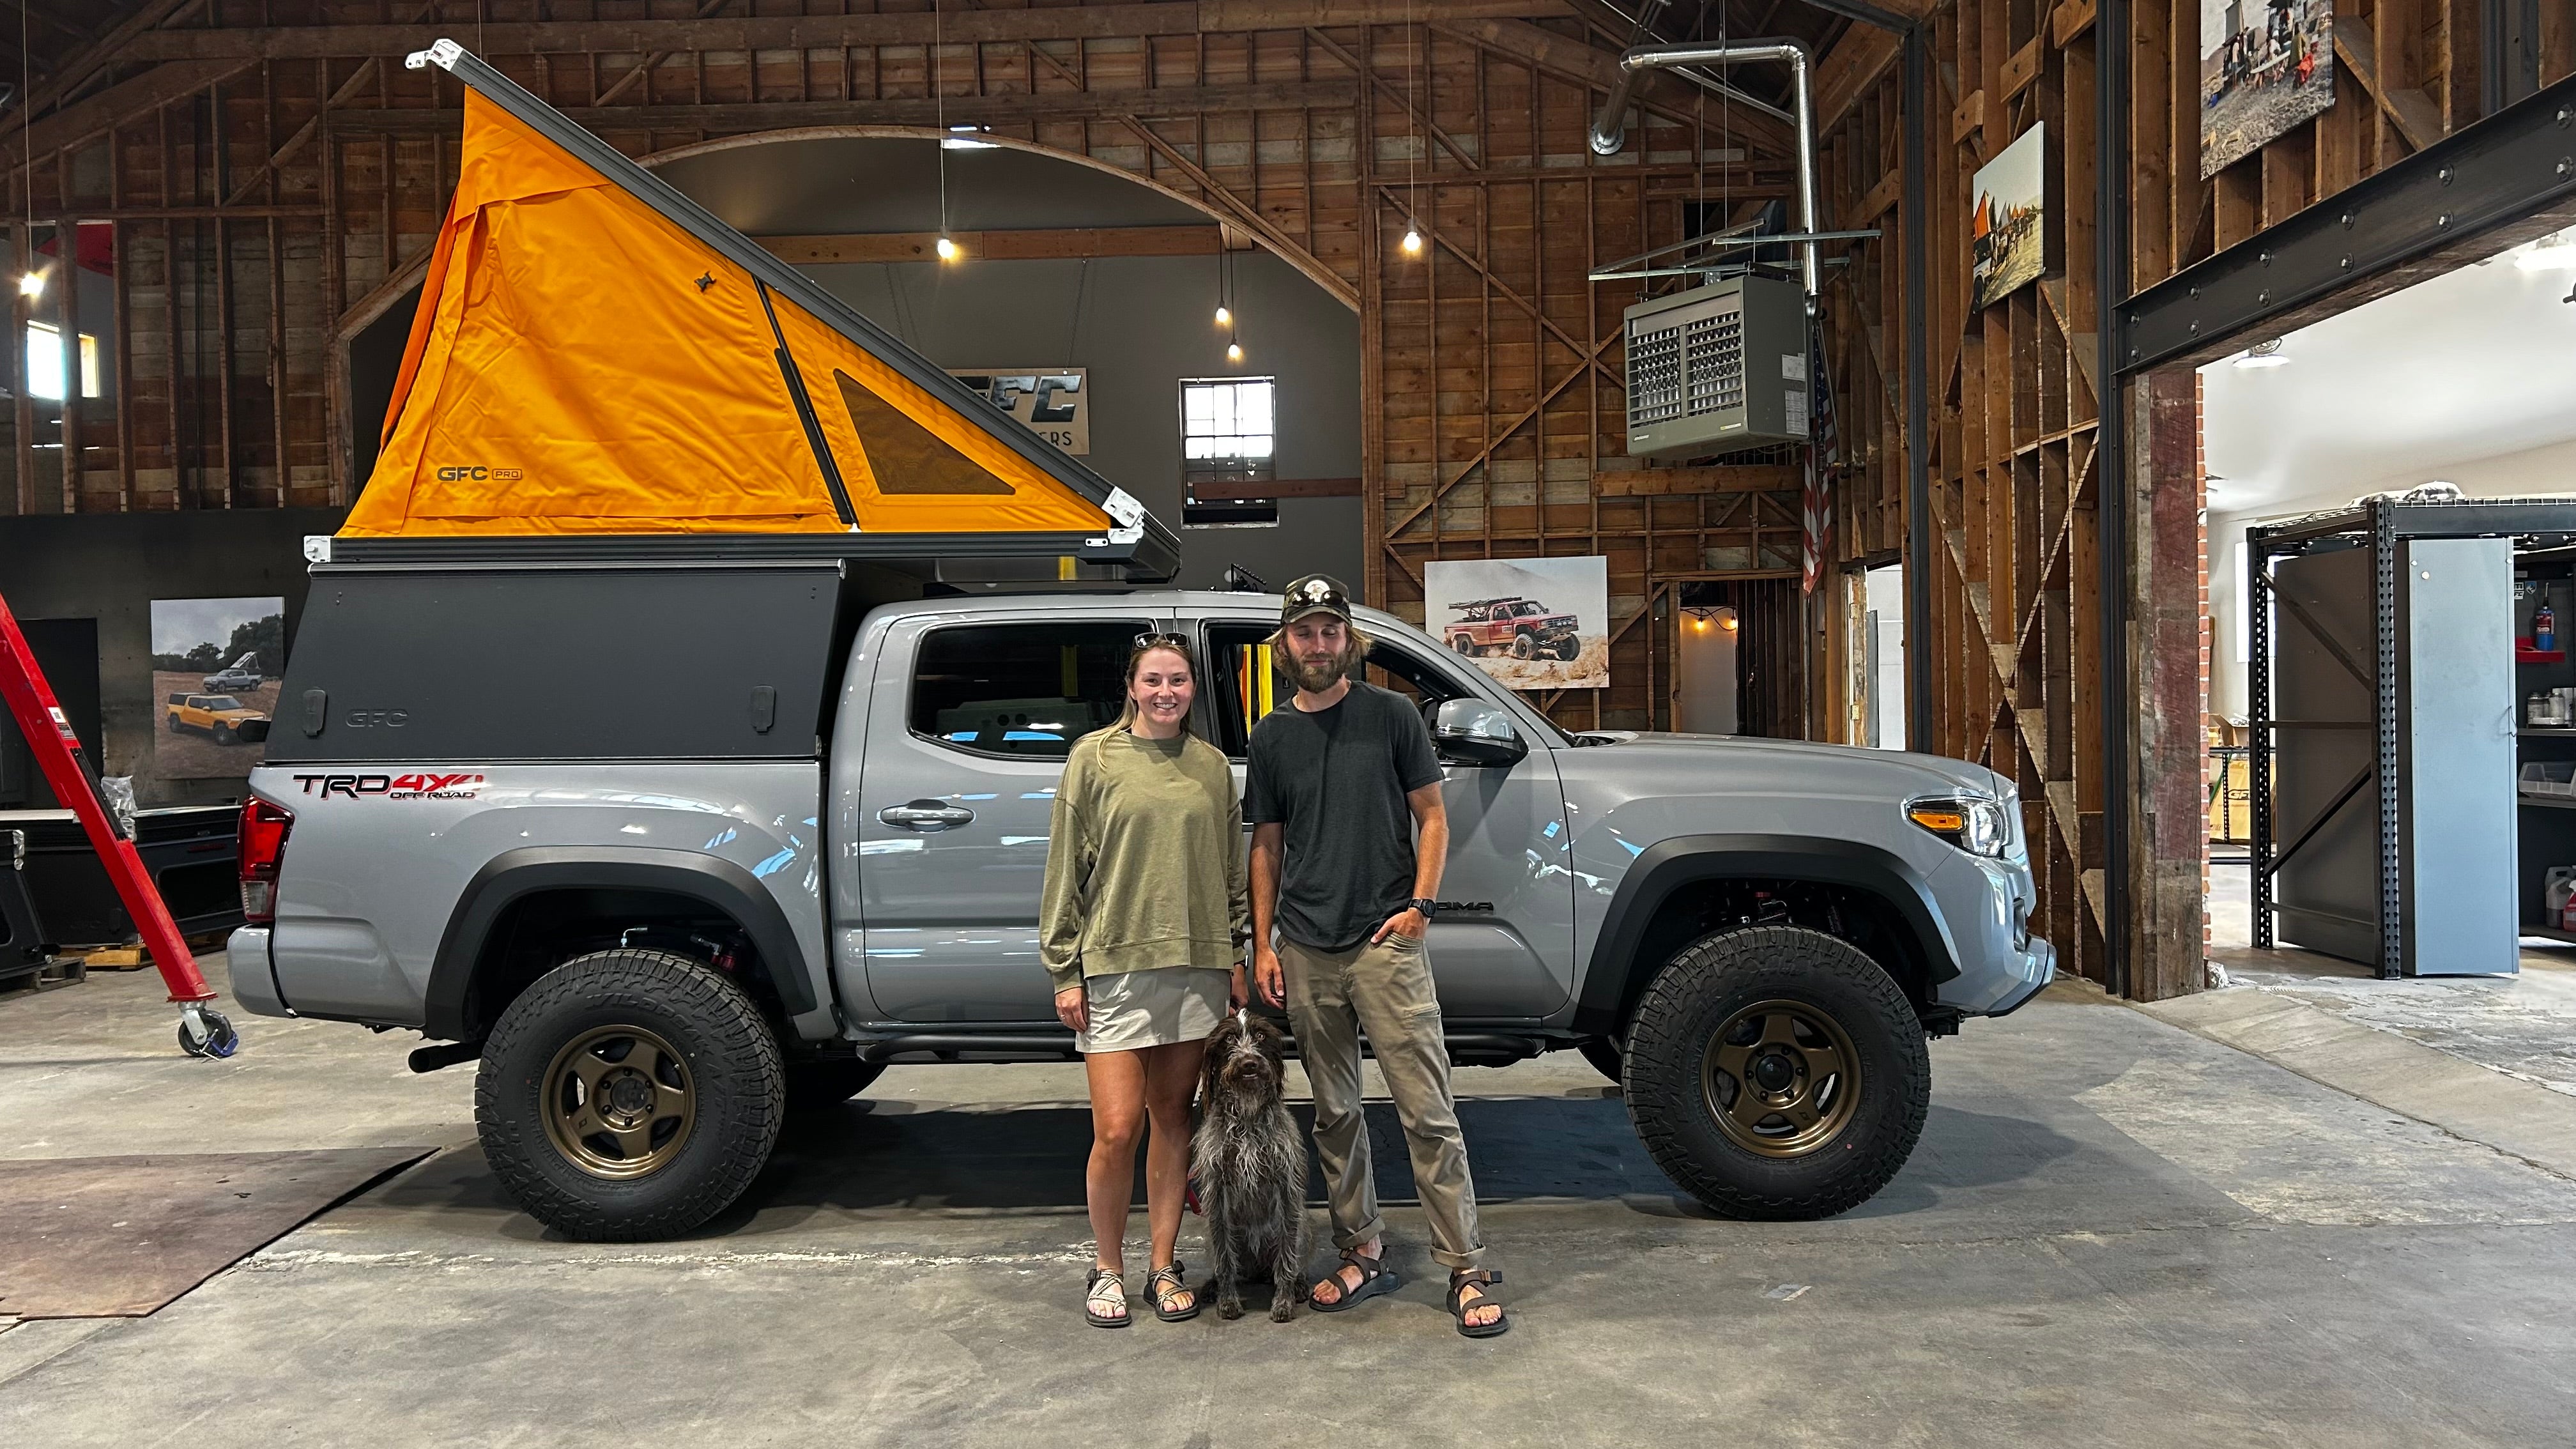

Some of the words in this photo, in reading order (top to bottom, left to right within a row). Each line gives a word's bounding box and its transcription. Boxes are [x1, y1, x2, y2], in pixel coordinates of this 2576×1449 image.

[437, 466, 488, 481] GFC
[346, 709, 409, 728] GFC
[293, 774, 392, 799] TRD
[2228, 789, 2250, 800] GF
[585, 992, 715, 1058] WILDPEAK
